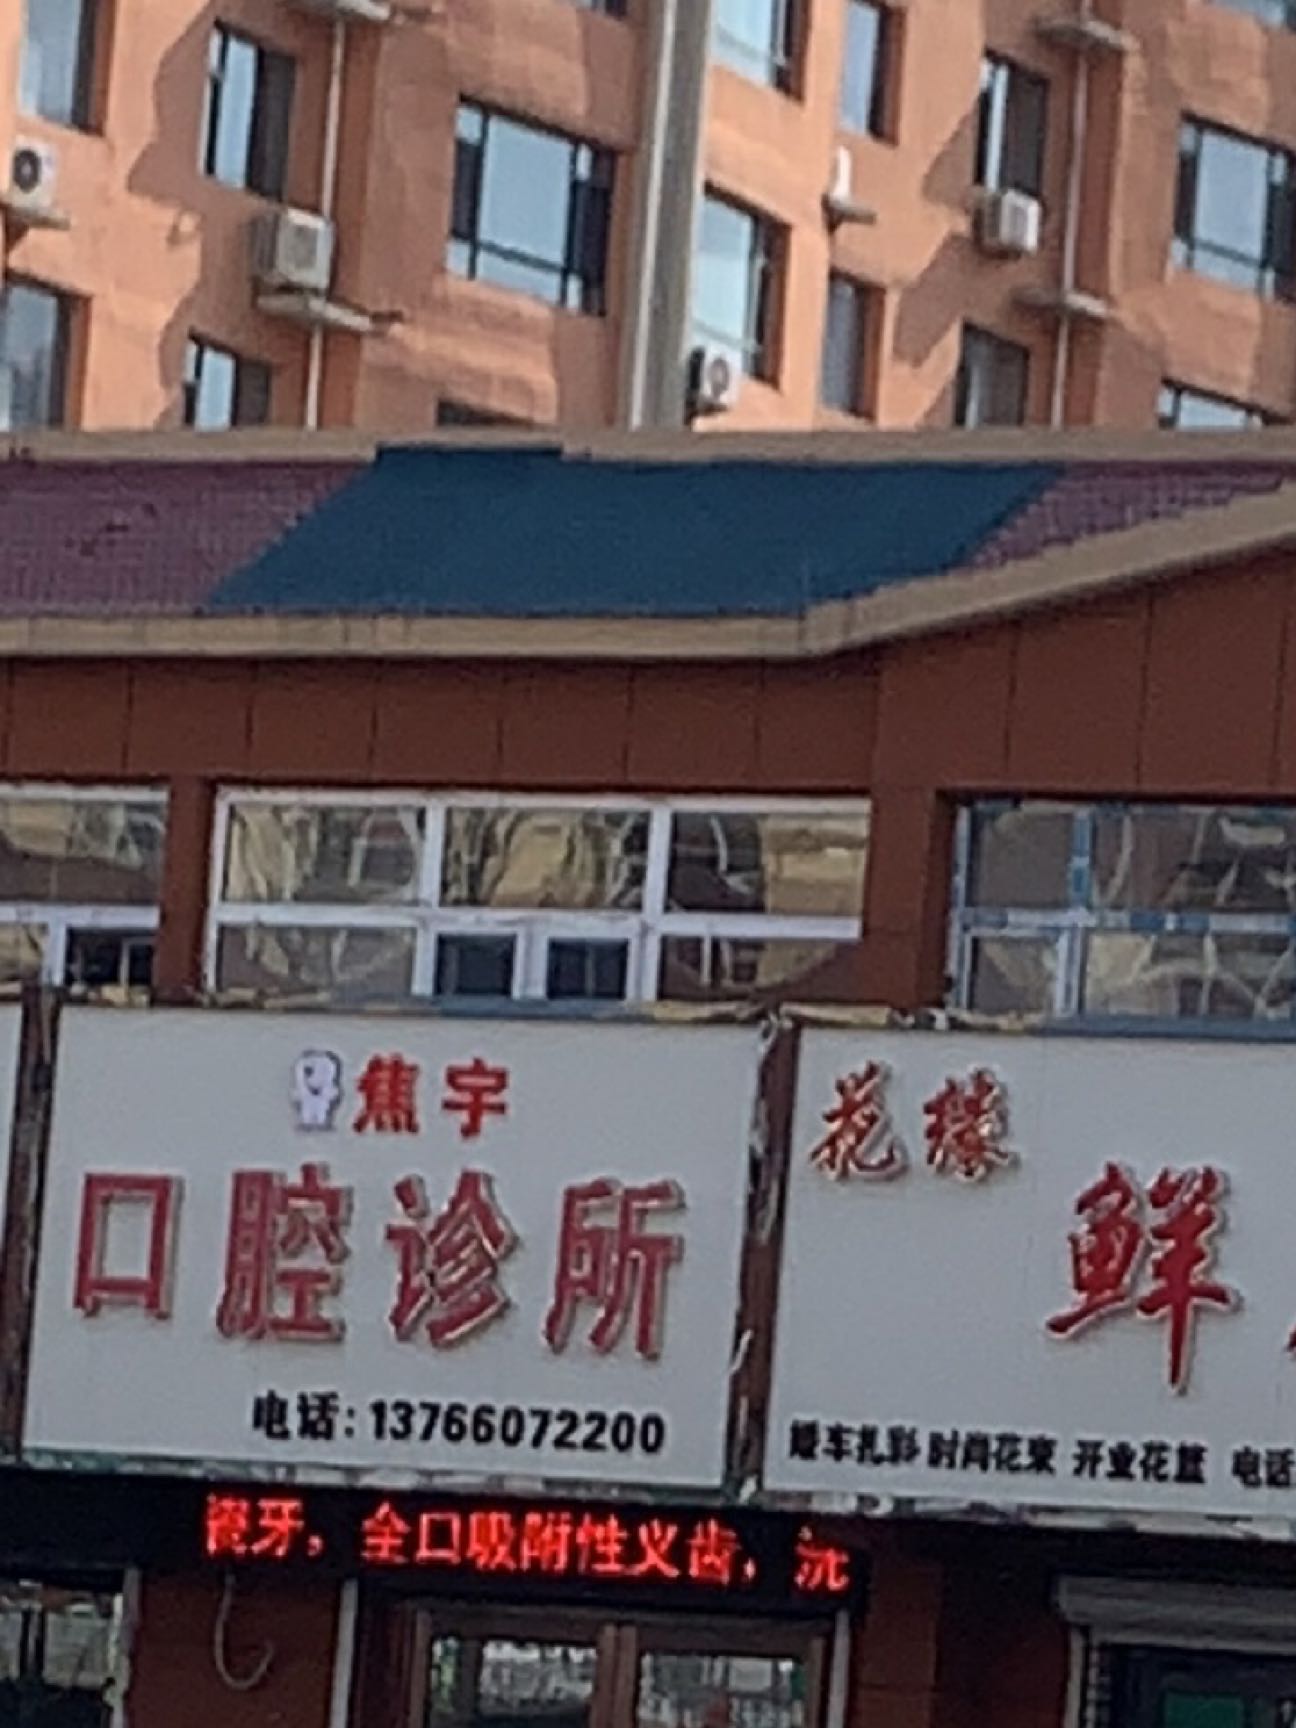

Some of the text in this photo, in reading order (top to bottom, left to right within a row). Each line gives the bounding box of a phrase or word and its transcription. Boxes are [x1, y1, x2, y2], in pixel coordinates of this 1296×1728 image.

[353, 1052, 511, 1138] 焦宇
[73, 1162, 686, 1361] 口腔诊所
